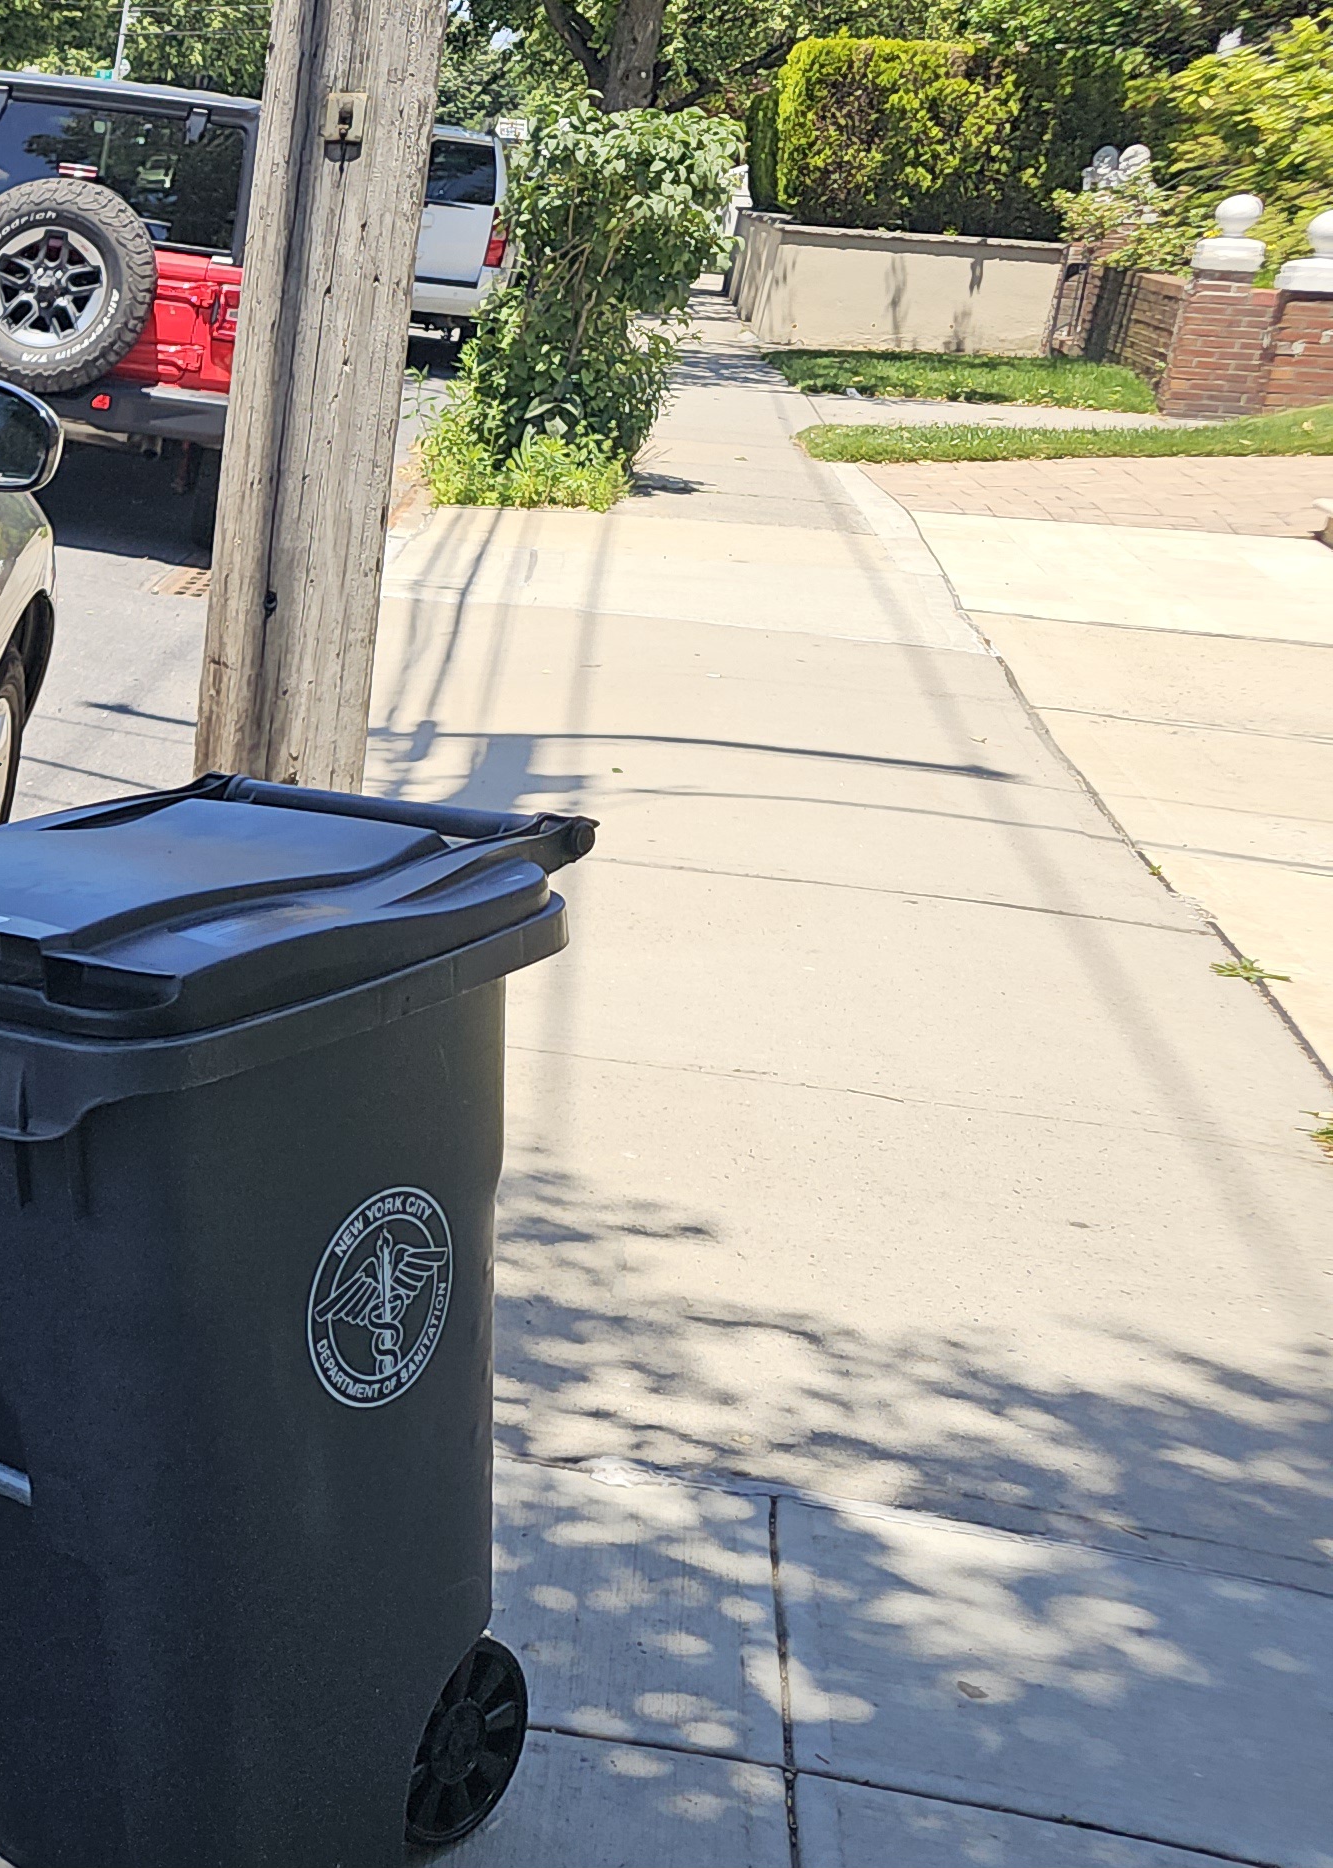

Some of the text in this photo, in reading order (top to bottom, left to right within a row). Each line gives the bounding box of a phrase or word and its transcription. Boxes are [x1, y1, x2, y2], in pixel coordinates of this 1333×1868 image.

[334, 1195, 433, 1257] NEW YORK CITY
[316, 1282, 447, 1398] DEPARTMENT OF SANITATION
